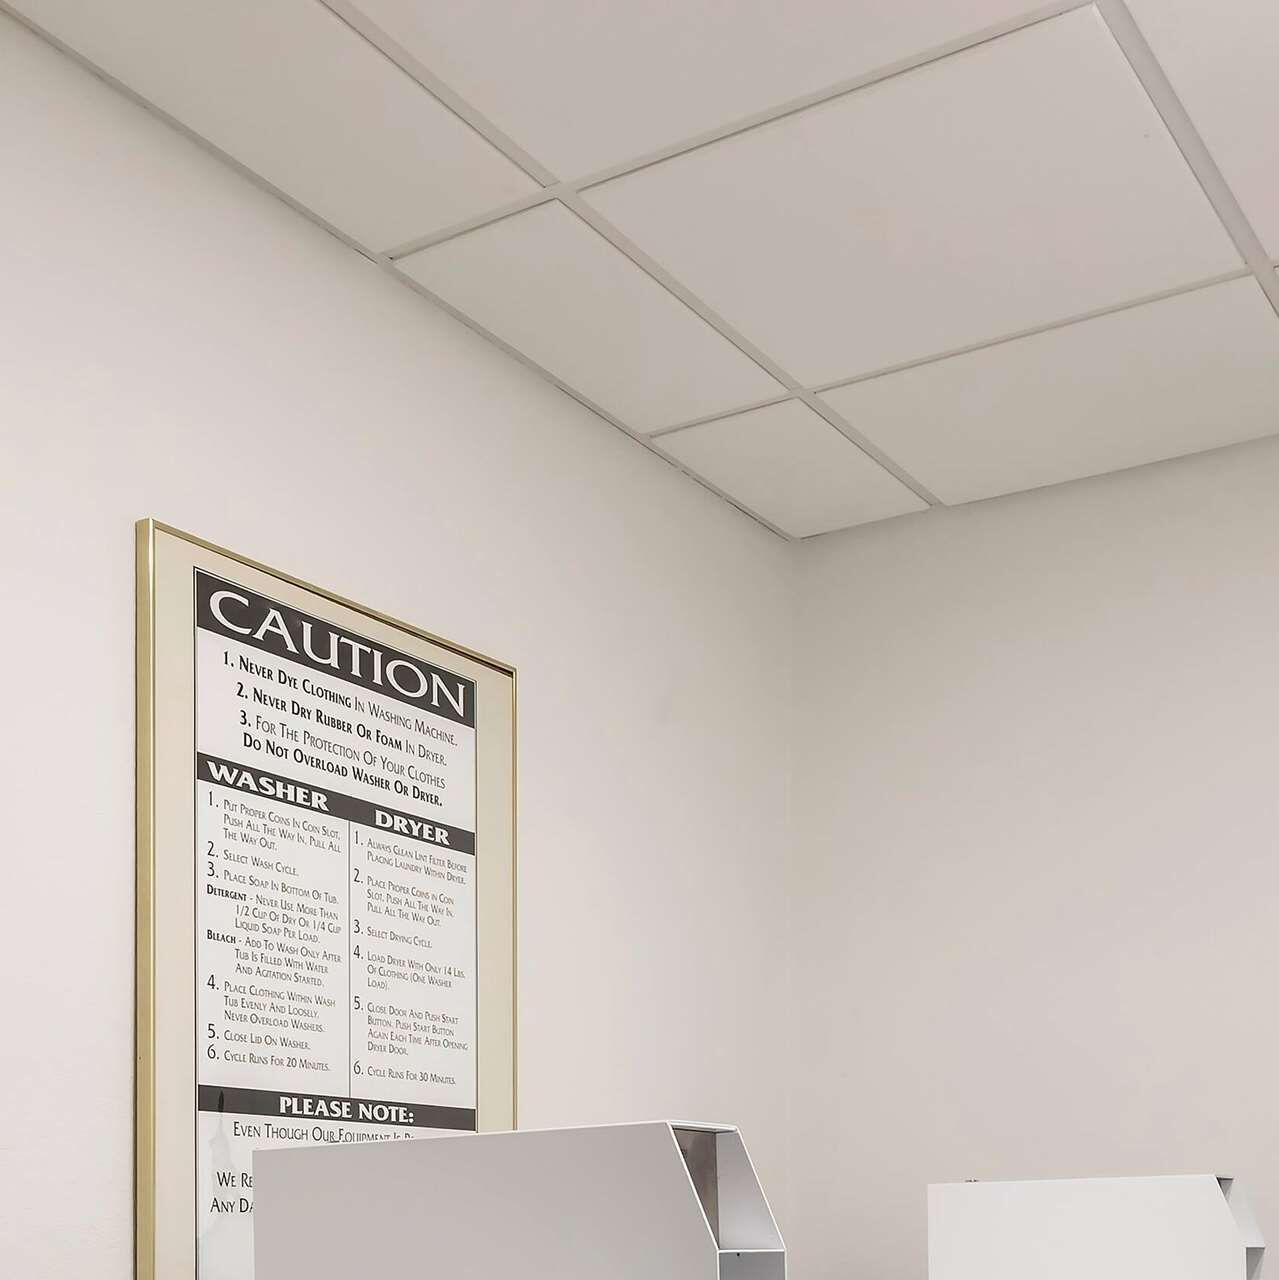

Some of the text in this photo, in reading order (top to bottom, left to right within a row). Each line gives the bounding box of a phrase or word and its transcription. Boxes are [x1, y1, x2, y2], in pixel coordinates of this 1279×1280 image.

[209, 590, 465, 718] CAUTION
[224, 651, 458, 746] 1. NEVER DYE CLOTHING IN WASHING MACHINE.
[236, 681, 447, 766] 2. NEVER DRY RUBBER OR FOAM IN DRYER.
[239, 709, 446, 790] 3. FOR THE PROTECTION OF YOUR CLOTHES
[243, 732, 443, 807] DO NOT OVERLOAD WASHER OR DRYER.
[206, 760, 330, 812] WASHER
[209, 790, 219, 808] 1.
[375, 809, 450, 846] DRYER
[207, 840, 219, 858] 2.
[207, 860, 219, 879] 3.
[353, 918, 364, 935] 3.
[207, 1043, 220, 1060] 6.
[353, 1060, 364, 1075] 6.
[279, 1096, 414, 1124] PLEASE NOTE:
[233, 1121, 261, 1138] EVEN
[264, 1123, 309, 1141] THOUGH
[312, 1126, 334, 1143] OUR
[216, 1171, 236, 1188] WE
[210, 1197, 236, 1213] ANY
